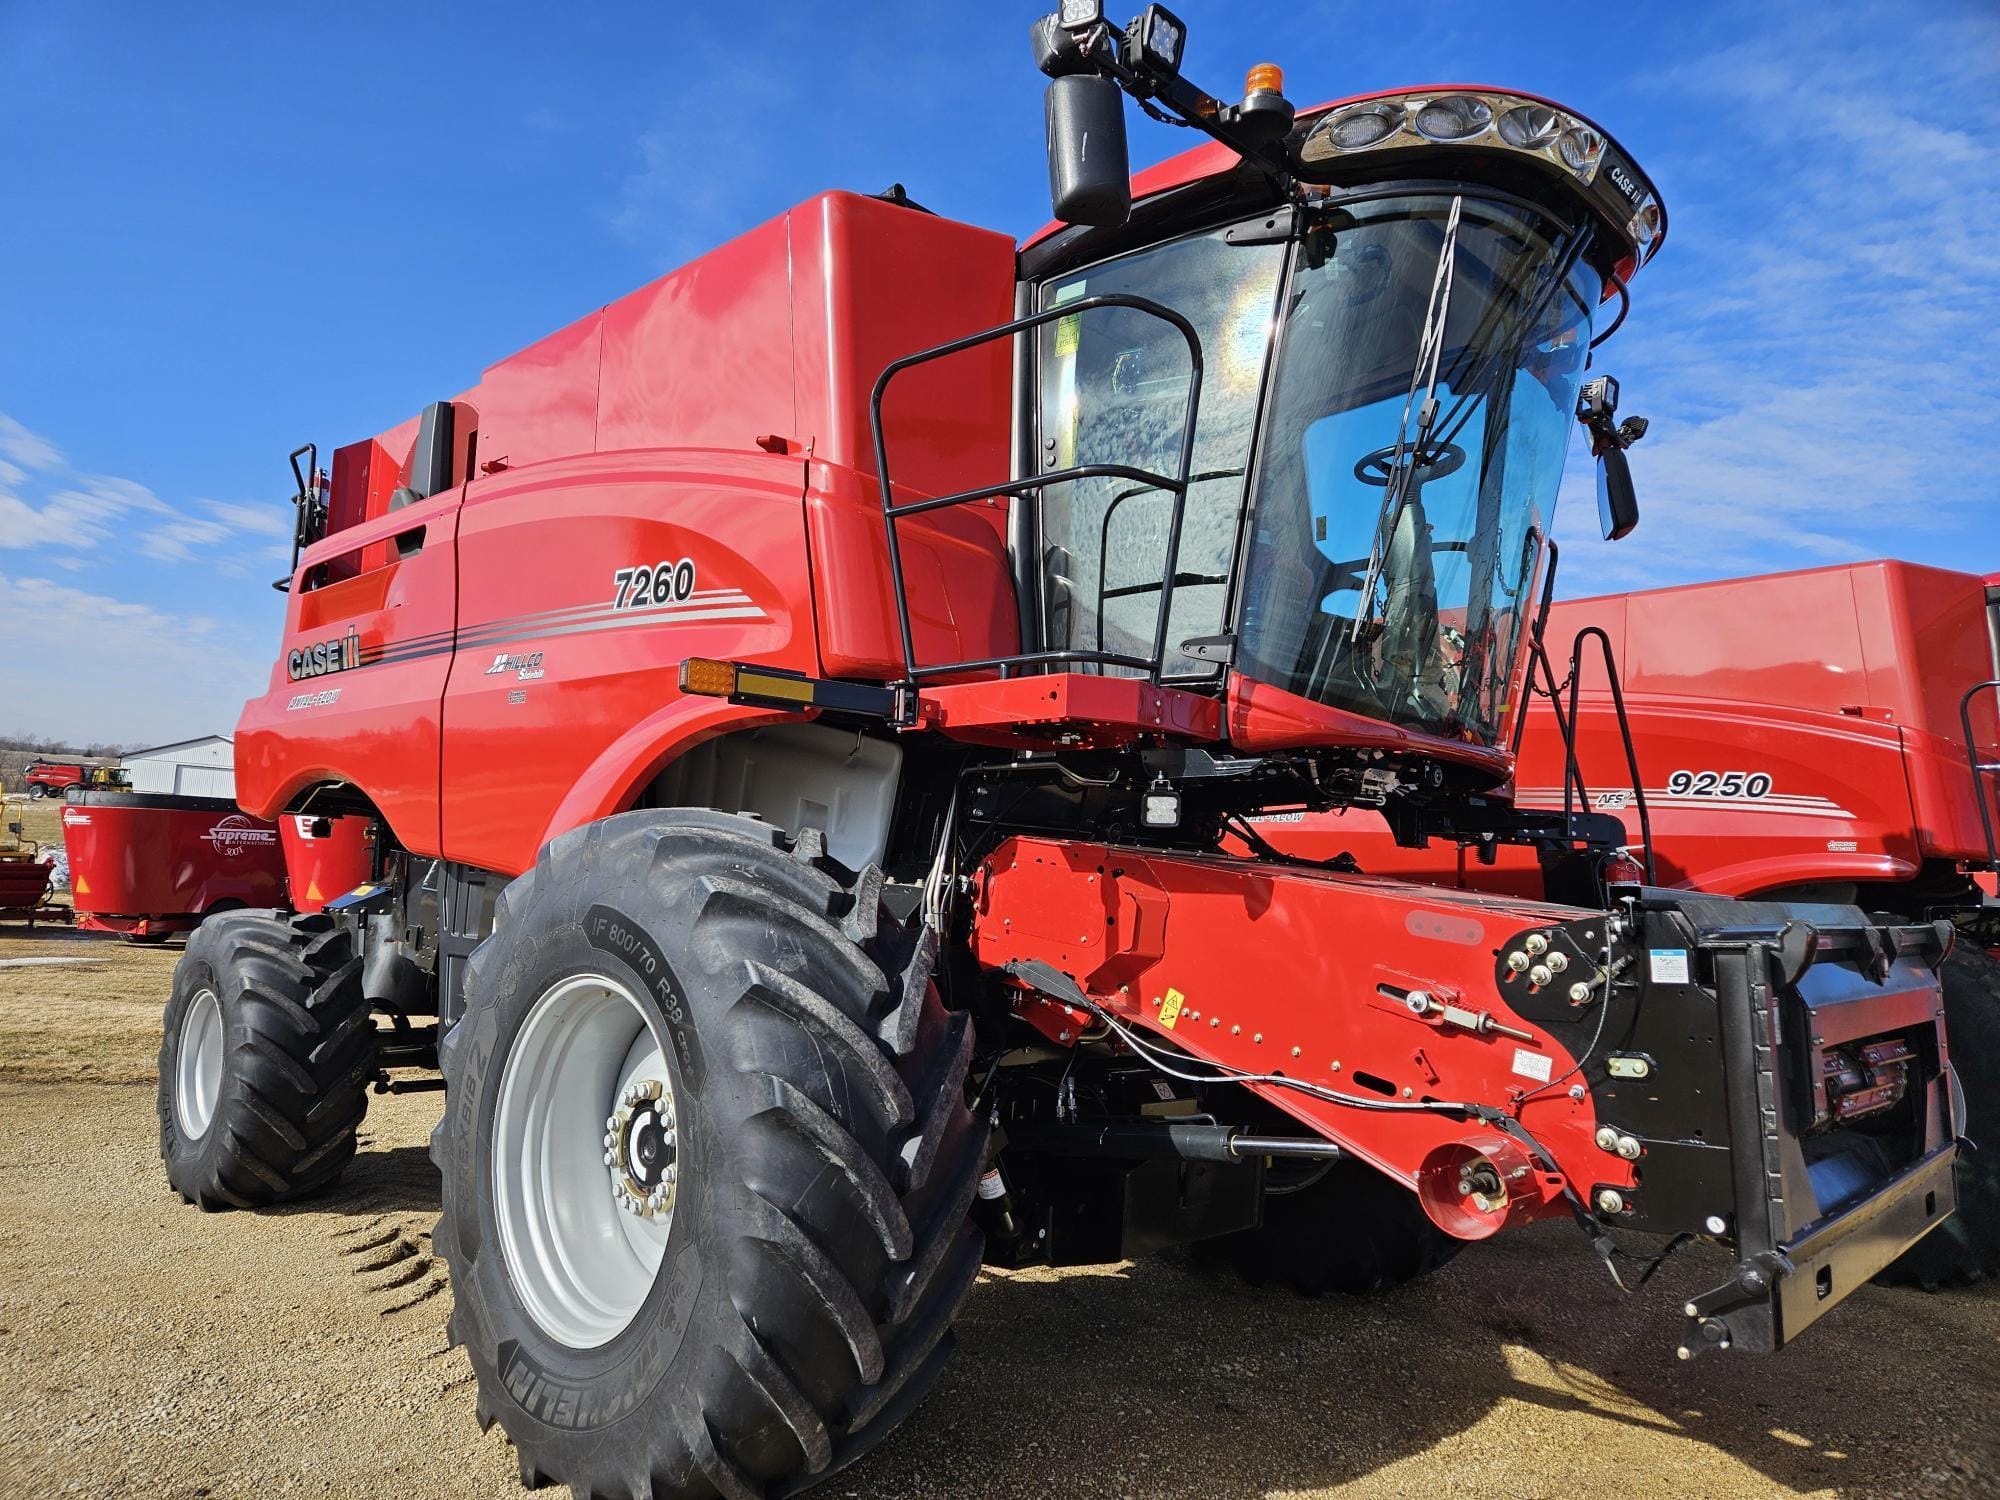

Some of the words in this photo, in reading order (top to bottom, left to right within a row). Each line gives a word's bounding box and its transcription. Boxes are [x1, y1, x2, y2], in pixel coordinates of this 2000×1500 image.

[1611, 167, 1634, 196] CASE
[613, 557, 695, 610] 7260
[287, 639, 340, 681] CASE
[1597, 793, 1625, 804] AFS
[1668, 770, 1772, 798] 9250
[200, 828, 276, 845] Supreme
[592, 917, 609, 937] IF
[656, 976, 684, 1026] R38
[469, 1039, 488, 1082] 2
